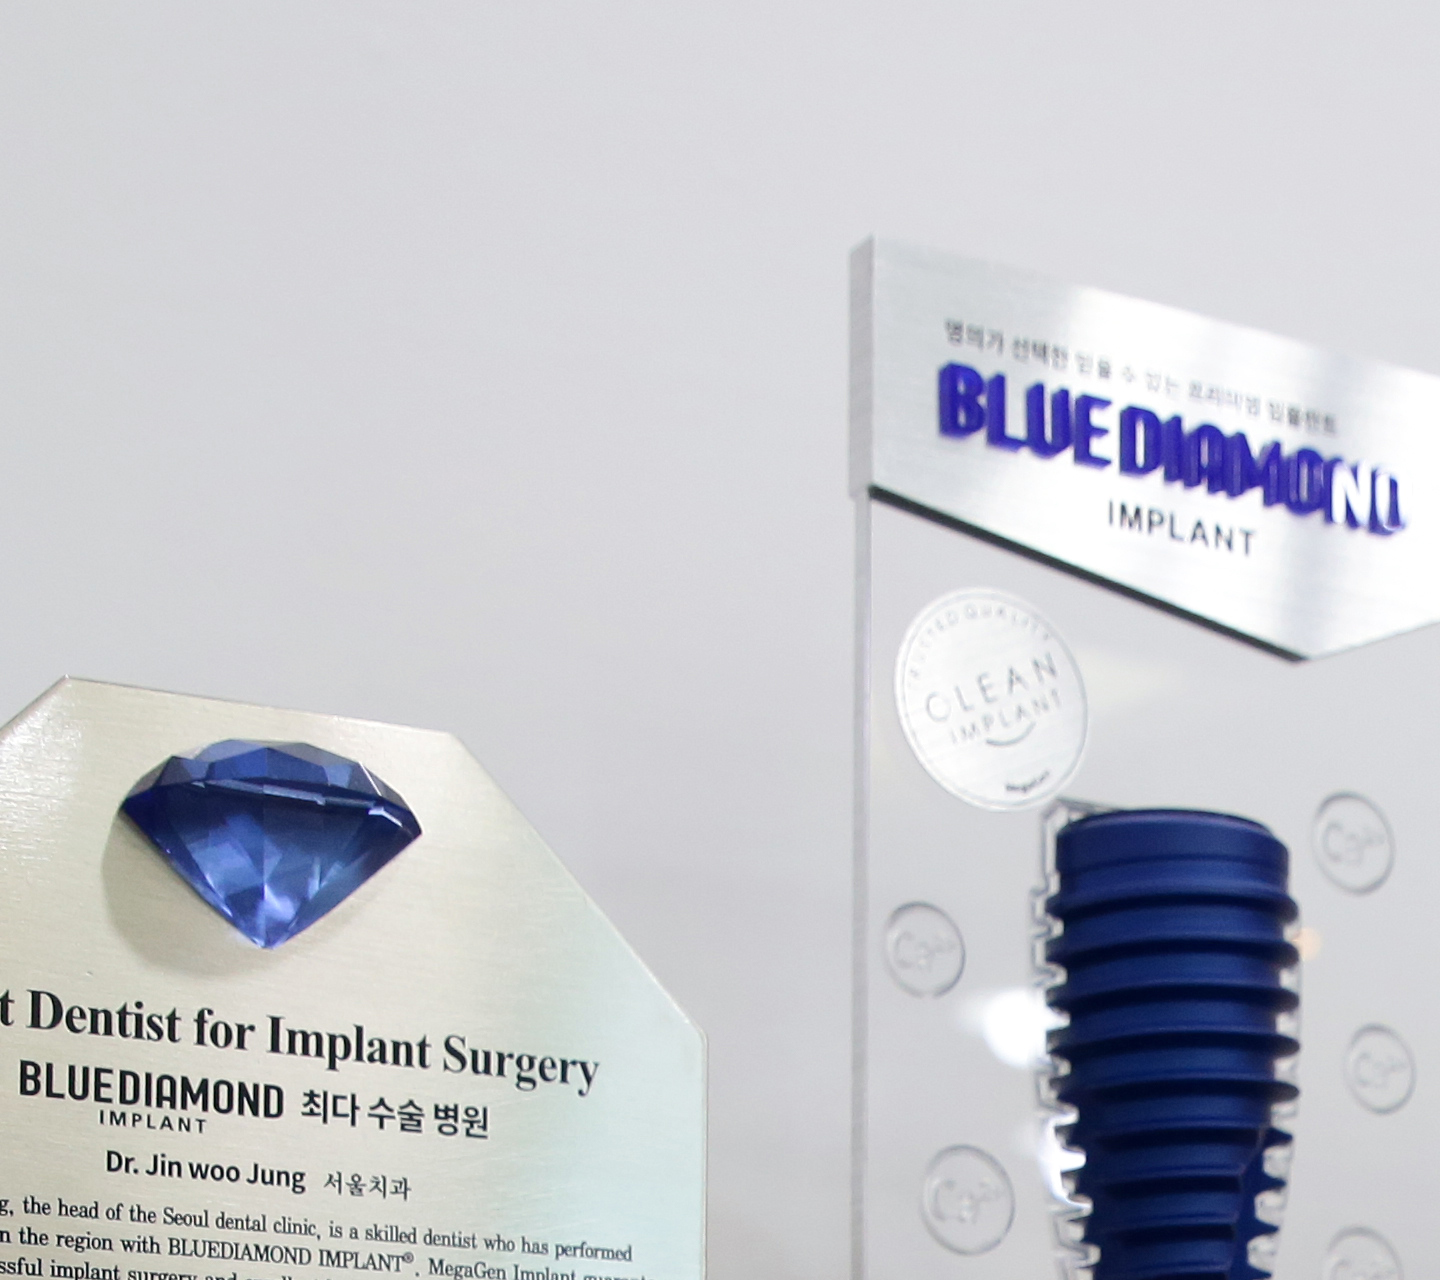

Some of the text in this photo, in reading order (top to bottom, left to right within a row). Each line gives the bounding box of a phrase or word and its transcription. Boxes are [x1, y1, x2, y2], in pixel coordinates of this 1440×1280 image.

[1108, 500, 1253, 555] IMPLANT
[26, 990, 182, 1043] Dentist
[193, 1008, 256, 1051] for
[266, 1015, 432, 1073] Implant
[443, 1035, 599, 1097] Surgery
[19, 1060, 284, 1119] BLUEDIAMOND
[301, 1089, 360, 1127] 최다
[99, 1109, 206, 1134] IMPLANT
[106, 1150, 411, 1201] Dr. Jin woo Jung 서울치과
[18, 1226, 49, 1246] the
[56, 1231, 114, 1253] region
[120, 1235, 161, 1255] with
[168, 1237, 312, 1266] BLUEDIAMOND
[428, 1257, 507, 1280] MegaGen
[22, 1195, 52, 1216] the
[57, 1197, 99, 1220] head
[105, 1202, 124, 1221] of
[129, 1204, 157, 1224] the
[162, 1206, 210, 1228] Seoul
[215, 1211, 267, 1233] dental
[272, 1215, 321, 1241] clinic,
[329, 1220, 343, 1239] is
[349, 1226, 360, 1241] a
[364, 1223, 418, 1245] skilled
[423, 1228, 477, 1249] dentist
[483, 1233, 516, 1252] who
[521, 1235, 549, 1255] has
[554, 1240, 633, 1262] performed
